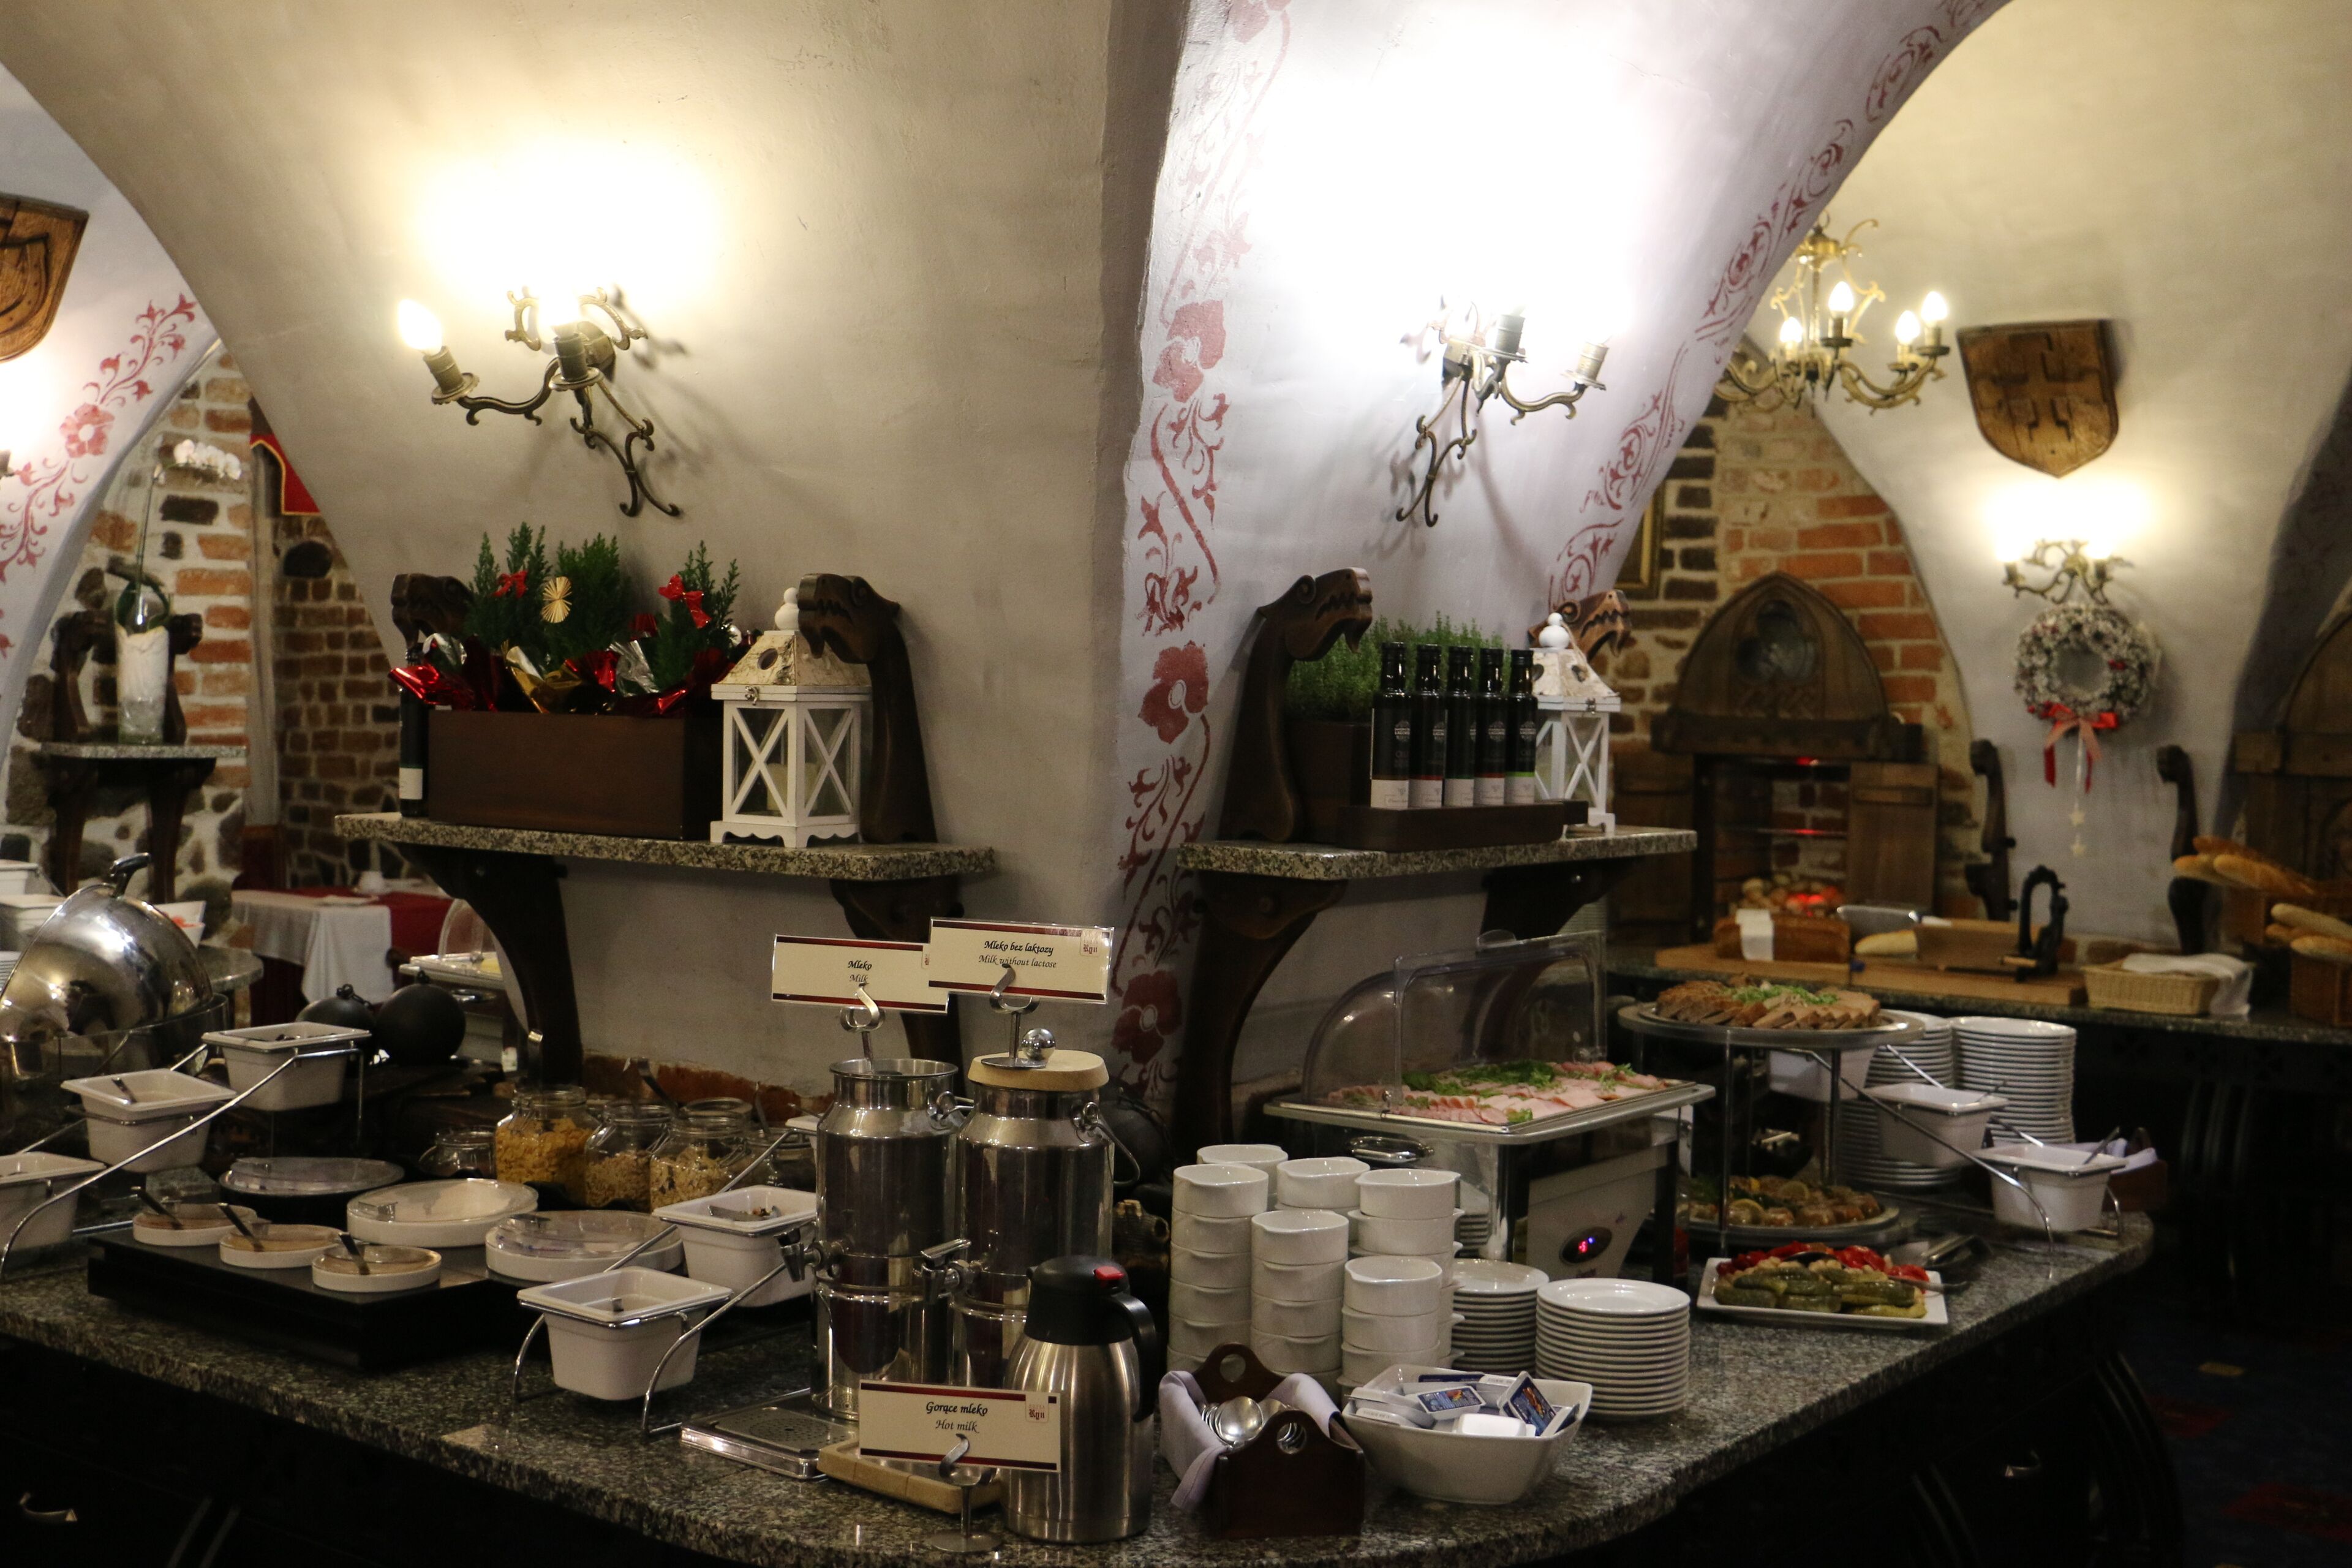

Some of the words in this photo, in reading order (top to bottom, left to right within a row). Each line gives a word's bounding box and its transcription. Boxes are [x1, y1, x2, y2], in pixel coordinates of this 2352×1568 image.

[984, 940, 1008, 952] Mleko
[1009, 942, 1023, 951] bez
[1025, 943, 1054, 957] laktozy
[848, 960, 872, 971] Mleko
[978, 955, 999, 965] Milk
[999, 956, 1030, 966] without
[1031, 957, 1057, 968] lactose
[849, 974, 870, 985] Milk
[926, 1401, 958, 1414] Gorące
[960, 1403, 988, 1417] mleko
[935, 1419, 954, 1430] Hot
[957, 1420, 980, 1434] milk
